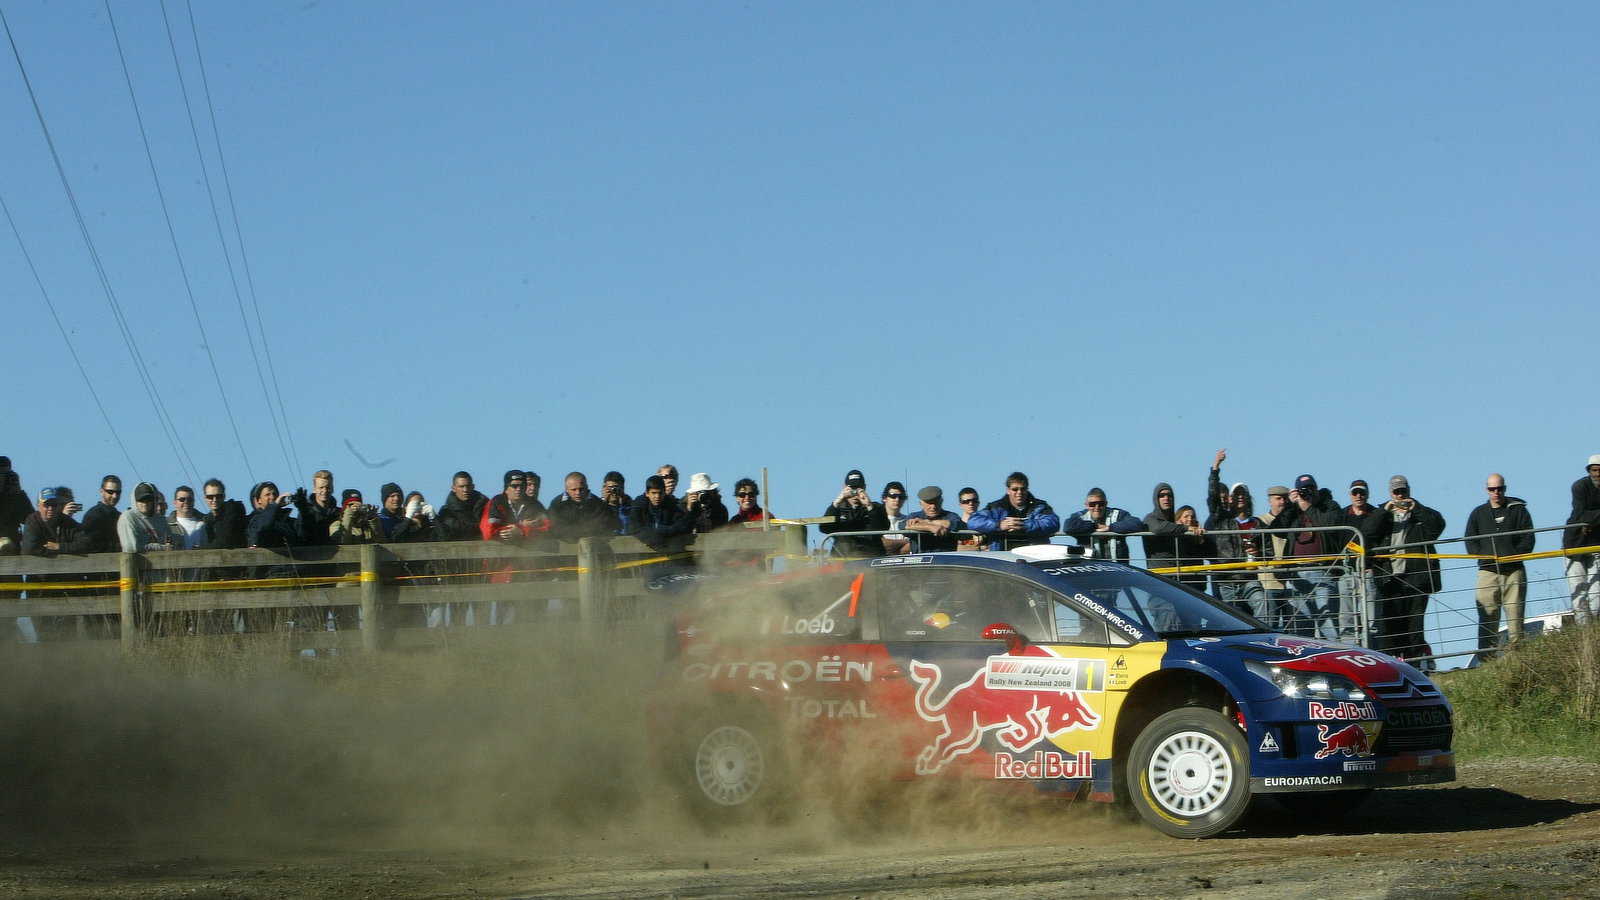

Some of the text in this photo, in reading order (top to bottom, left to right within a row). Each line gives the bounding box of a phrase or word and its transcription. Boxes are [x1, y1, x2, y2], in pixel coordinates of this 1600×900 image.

[847, 572, 864, 617] 1
[781, 614, 835, 634] Loeb
[1074, 593, 1144, 640] CITROEN-WRC.COM
[682, 655, 873, 683] CITROËN
[1085, 661, 1095, 691] 1
[989, 678, 1006, 687] Rally
[1024, 679, 1052, 687] Zealand
[1054, 680, 1072, 688] 2008
[783, 696, 877, 718] TOTAL
[1309, 702, 1377, 720] Red Bull
[995, 750, 1093, 779] Red Bull
[1343, 760, 1376, 772] PIRELLI
[1264, 776, 1343, 787] EURODATACAR
